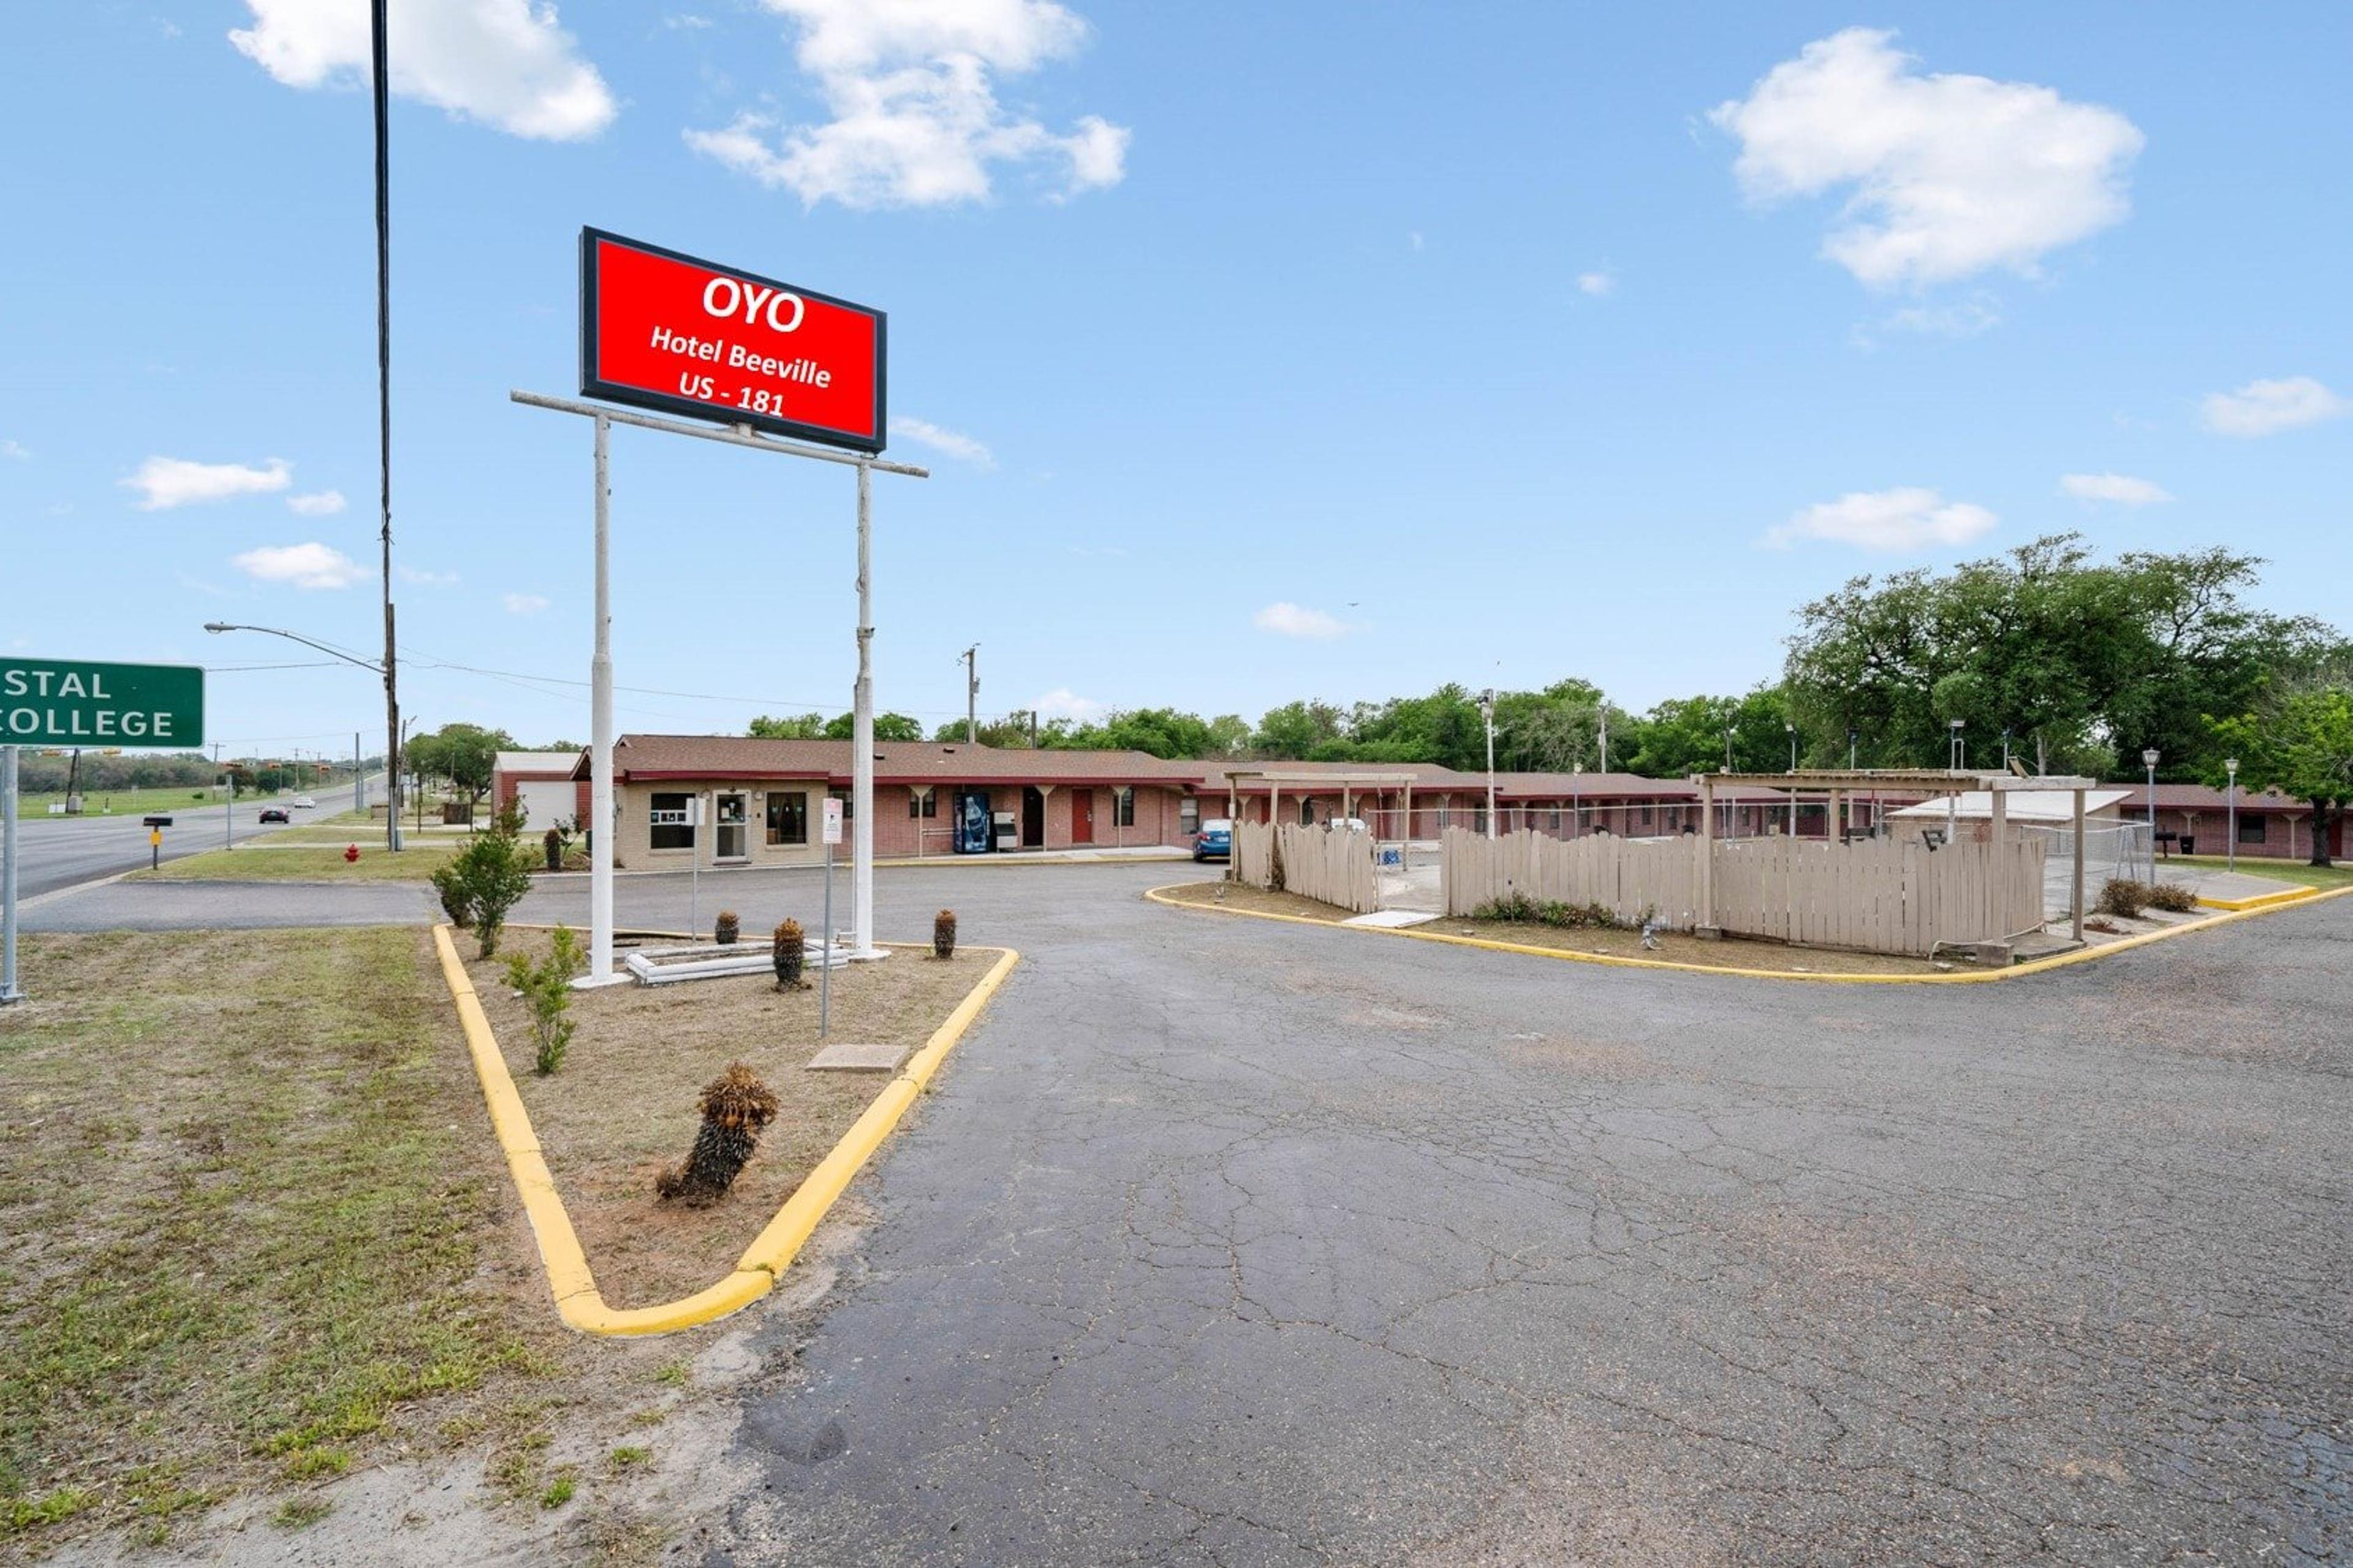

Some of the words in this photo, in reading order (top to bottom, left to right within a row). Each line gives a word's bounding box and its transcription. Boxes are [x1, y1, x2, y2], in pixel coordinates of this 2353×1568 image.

[703, 277, 805, 333] OYO
[651, 325, 723, 363] Hotel
[729, 344, 832, 388] Beeville
[680, 372, 714, 399] US
[737, 387, 784, 417] 181
[4, 669, 112, 699] STAL
[0, 707, 173, 737] OLLEGE
